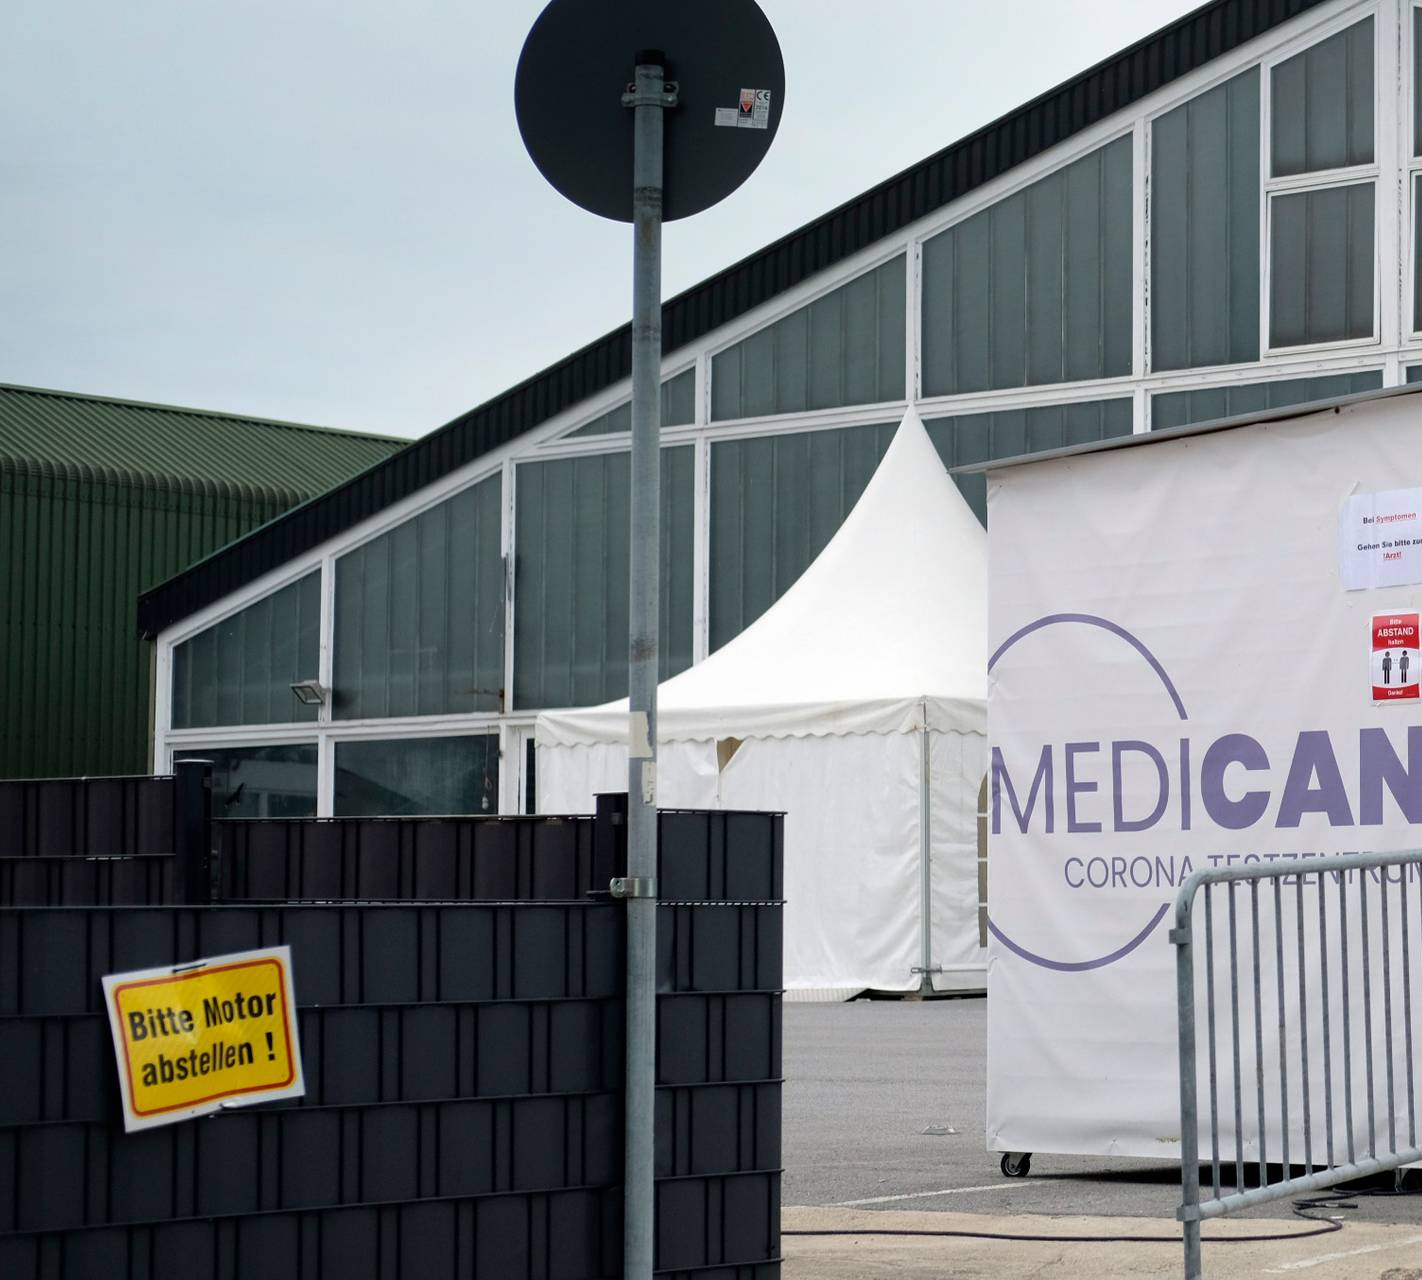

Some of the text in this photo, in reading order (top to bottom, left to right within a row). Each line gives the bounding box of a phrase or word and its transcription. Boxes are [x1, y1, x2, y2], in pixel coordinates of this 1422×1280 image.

[1363, 512, 1417, 525] Bei Symptomen
[1357, 543, 1380, 551] Gehen
[1382, 541, 1393, 549] Sie
[1394, 539, 1411, 547] bitte
[1377, 627, 1414, 637] ABSTAND
[1064, 855, 1194, 888] CORONA
[128, 992, 276, 1042] Bitte Motor
[141, 1031, 276, 1087] abstellen !
